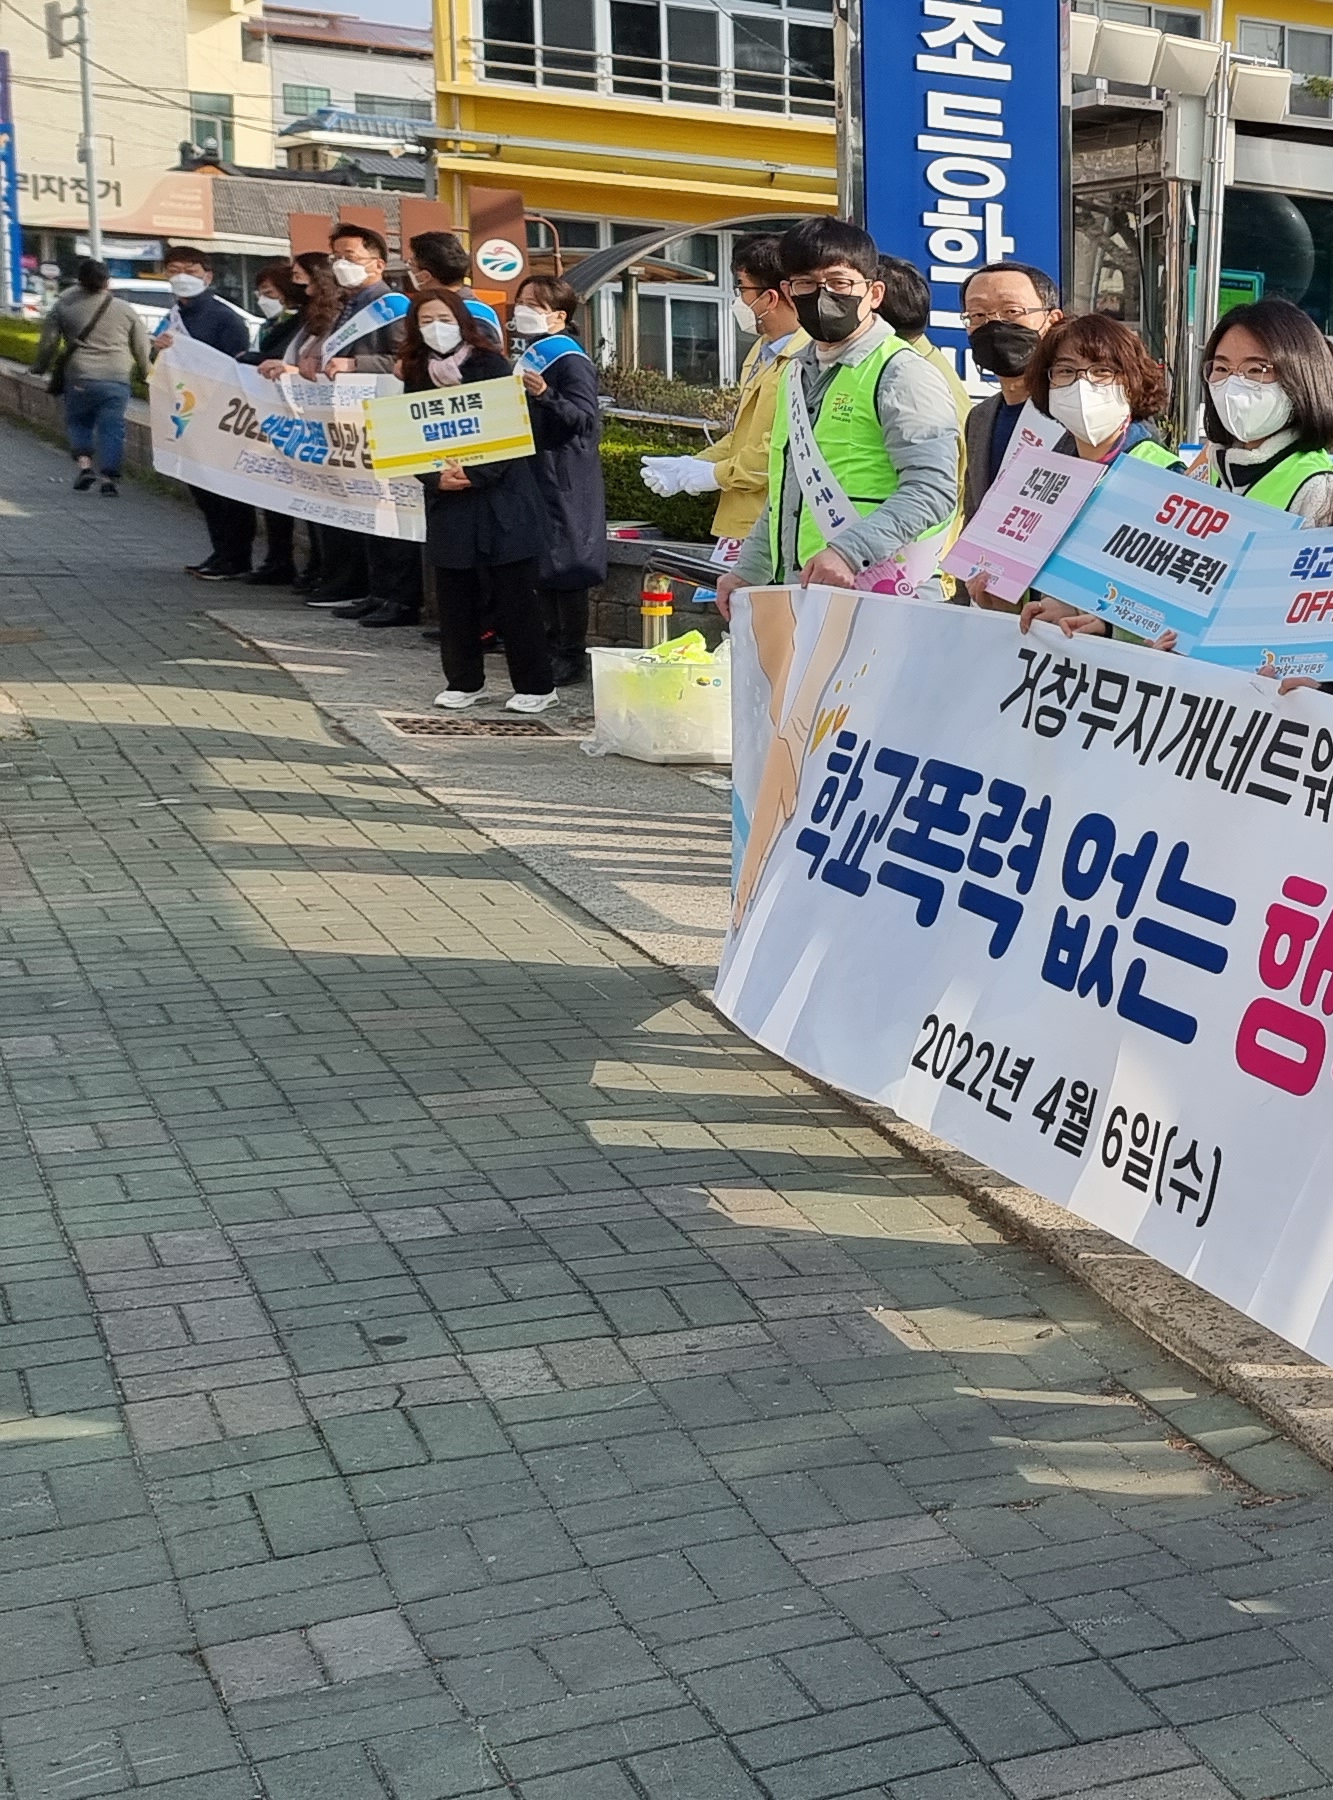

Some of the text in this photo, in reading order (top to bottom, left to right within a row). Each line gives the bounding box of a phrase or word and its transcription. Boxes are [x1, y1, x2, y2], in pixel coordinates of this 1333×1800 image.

[410, 392, 483, 421] 이쪽 저쪽
[422, 416, 481, 443] 살펴요!
[806, 466, 847, 528] 마세요
[997, 505, 1043, 543] 로그인!
[1156, 494, 1231, 540] STOP
[1102, 523, 1229, 596] 사이버폭력!
[795, 729, 1052, 960] 학교폭력
[1040, 811, 1238, 1046] 없는
[910, 1012, 1224, 1228] 2022년 4월 6일(수)
